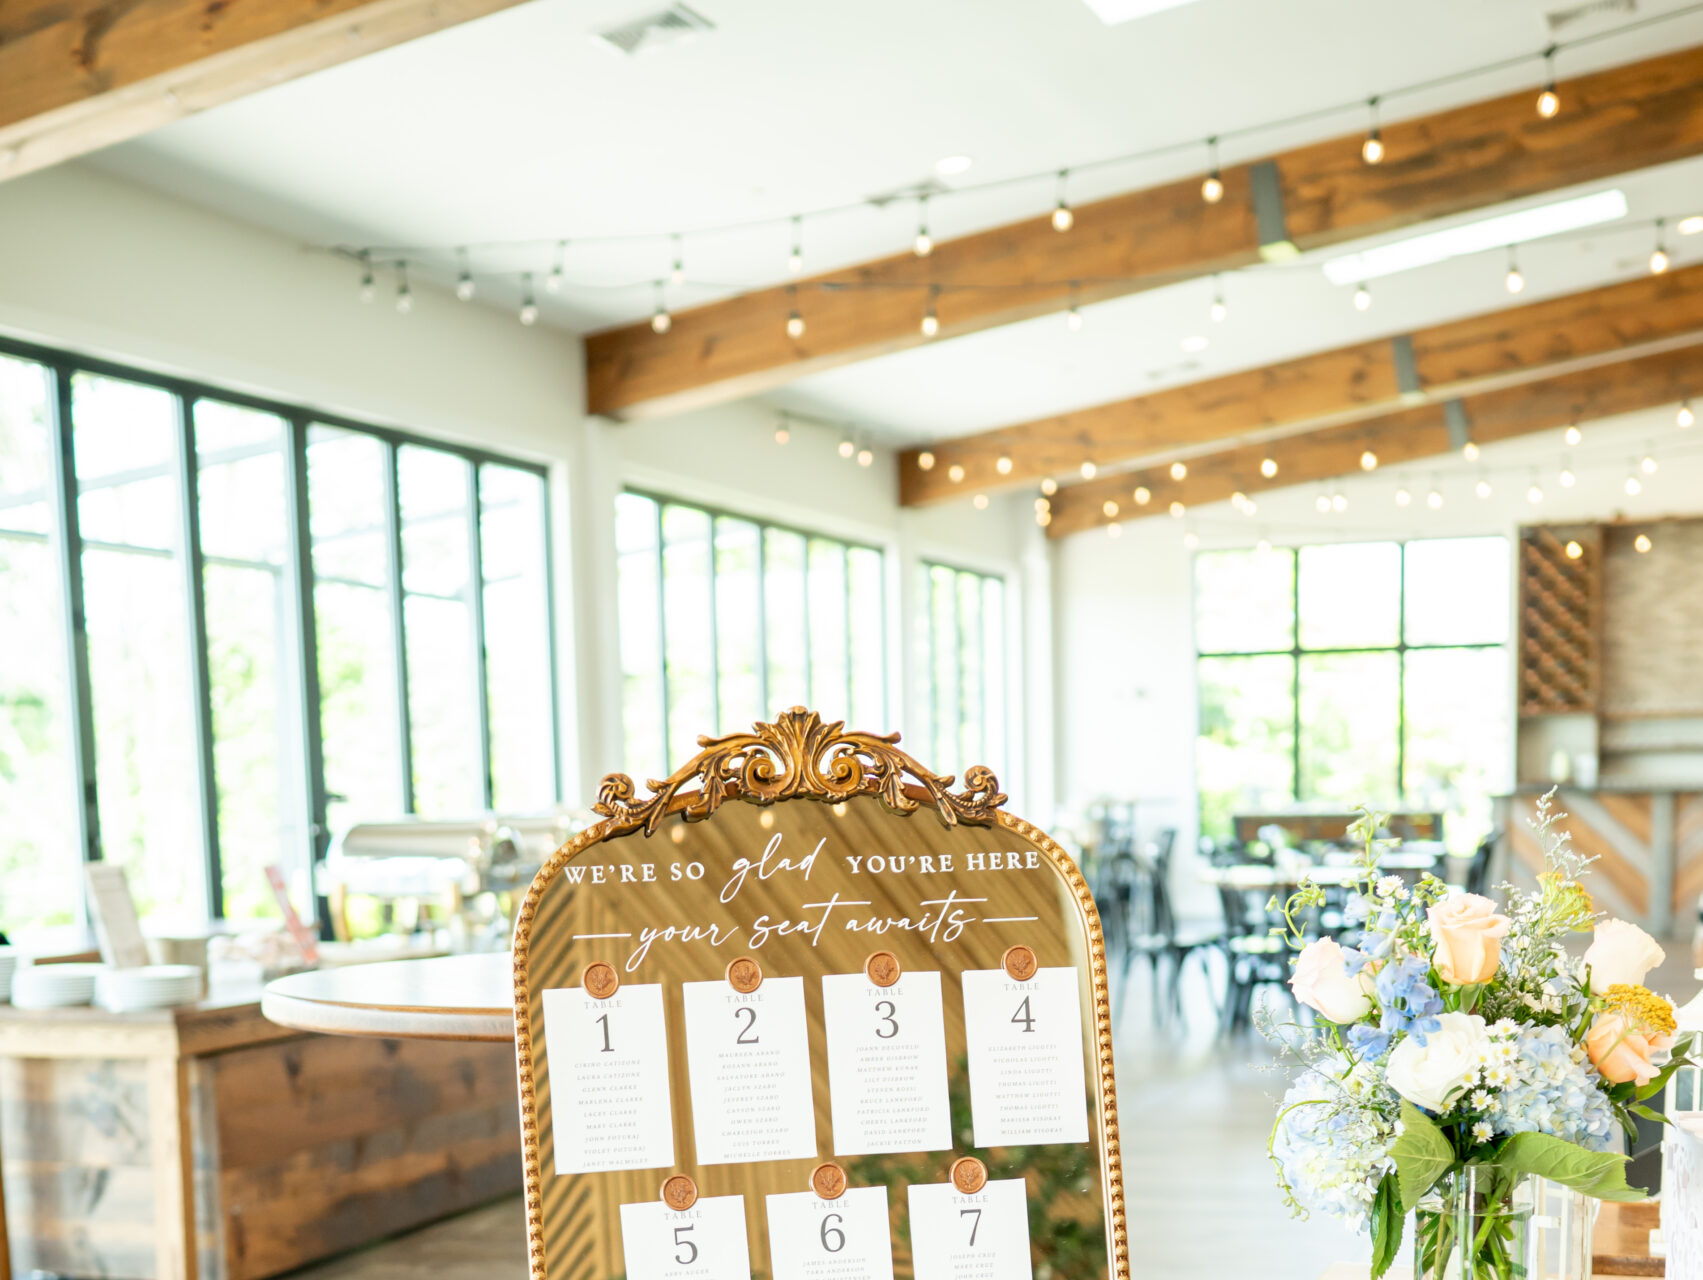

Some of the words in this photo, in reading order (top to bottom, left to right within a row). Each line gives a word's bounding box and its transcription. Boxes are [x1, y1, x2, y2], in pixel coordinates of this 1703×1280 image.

[563, 862, 658, 886] WE'RE
[669, 861, 705, 882] SO
[719, 832, 827, 903] glad
[846, 853, 955, 875] YOU'RE
[966, 850, 1041, 871] HERE
[625, 920, 740, 973] your
[749, 892, 872, 948] seat
[845, 889, 988, 944] awaits
[584, 1000, 622, 1009] TABLE
[725, 994, 764, 1003] TABLE
[866, 988, 904, 996] TABLE
[1004, 983, 1040, 991] TABLE
[735, 1007, 759, 1044] 2
[875, 1001, 899, 1038] 3
[1011, 995, 1036, 1032] 4
[596, 1013, 614, 1052] 1
[664, 1211, 702, 1220] TABLE
[812, 1200, 850, 1209] TABLE
[952, 1195, 989, 1203] TABLE
[674, 1224, 698, 1264] 5
[821, 1214, 845, 1252] 6
[960, 1209, 981, 1246] 7
